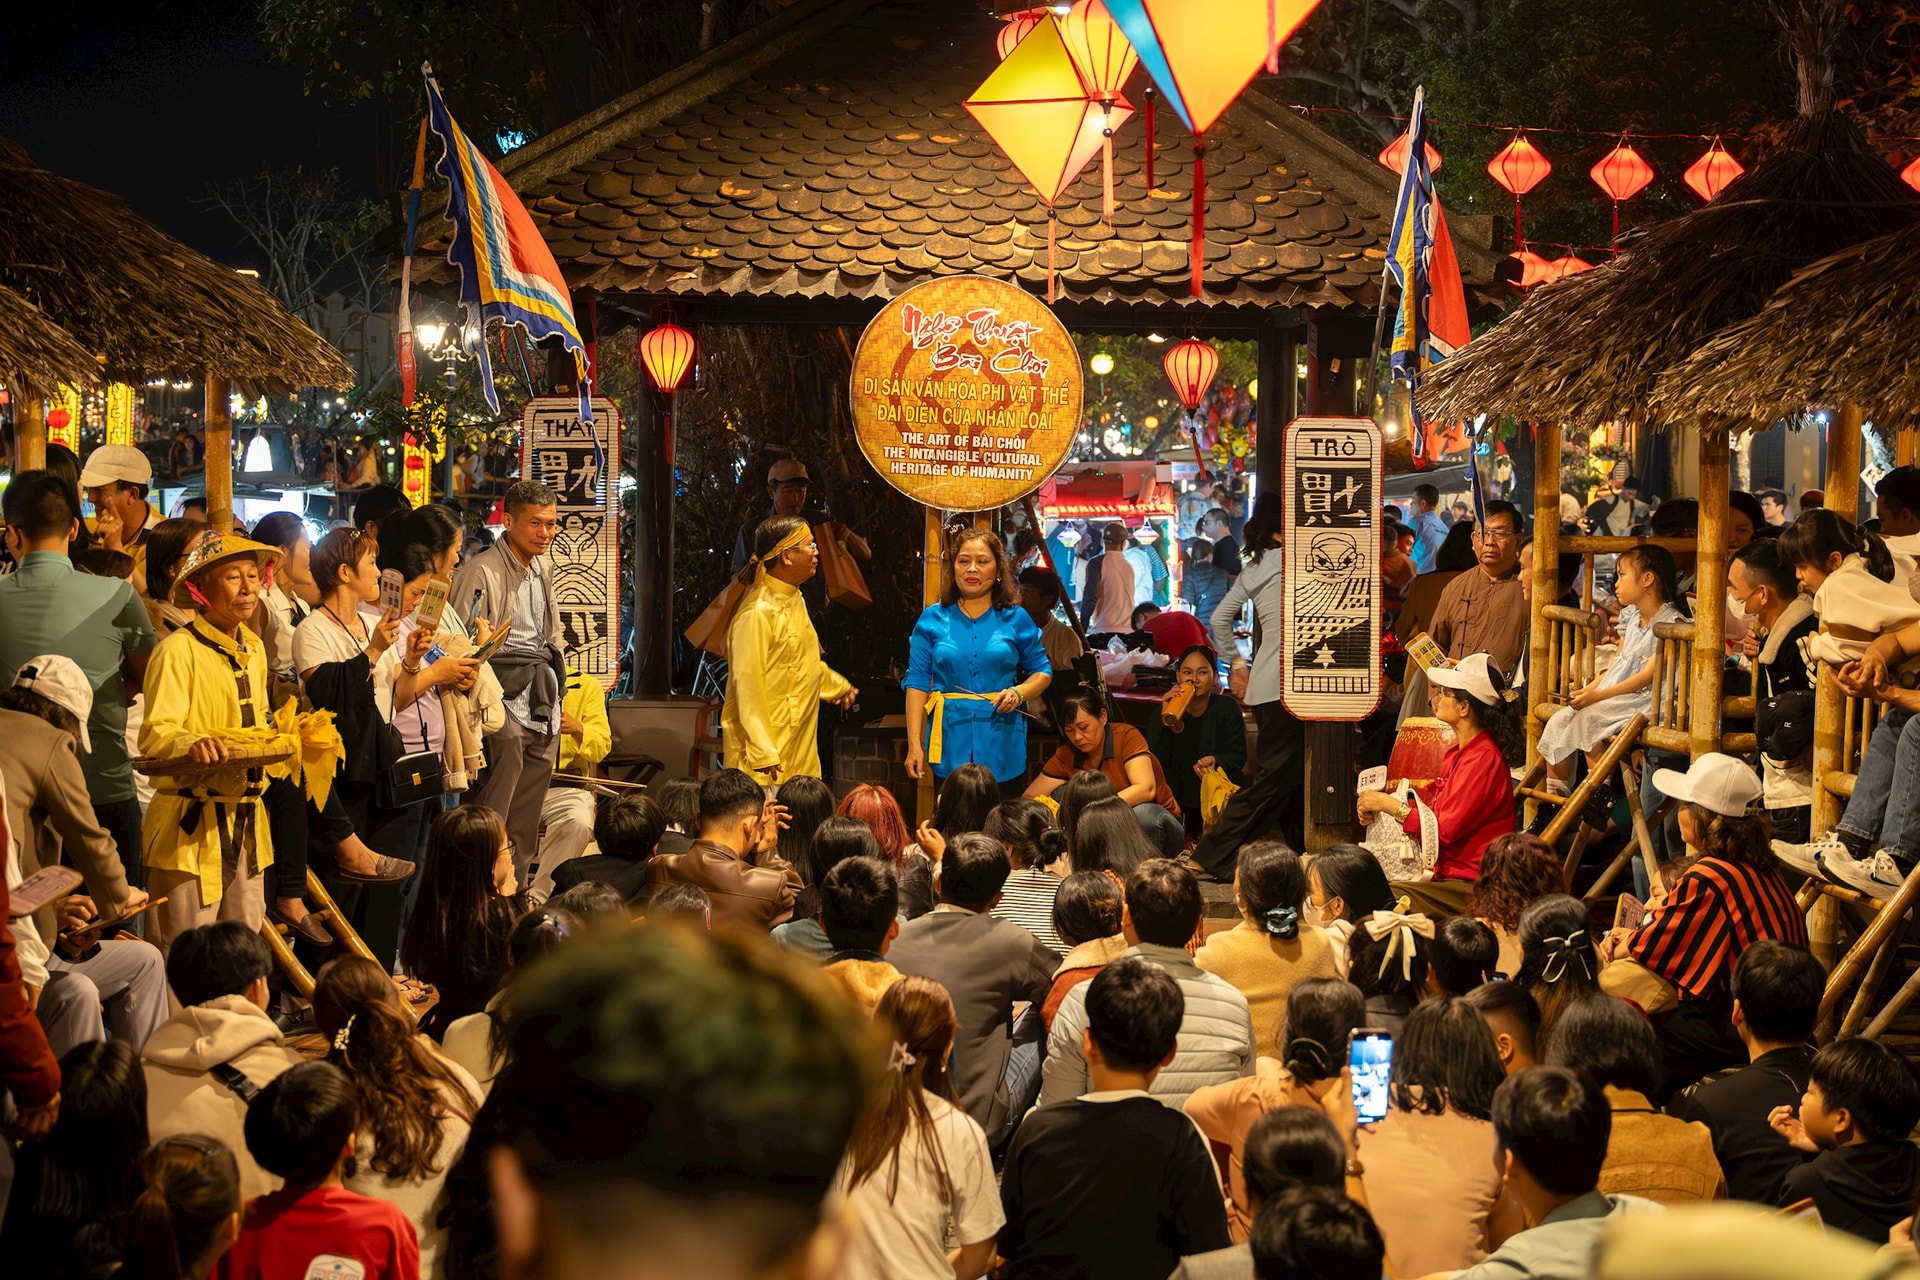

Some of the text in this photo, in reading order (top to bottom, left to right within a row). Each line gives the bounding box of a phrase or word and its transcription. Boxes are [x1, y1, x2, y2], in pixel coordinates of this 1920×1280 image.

[864, 372, 1069, 406] DI SẢN VĂN HÓA PHI VẬT THỂ
[877, 401, 1053, 433] ĐẠI DIỆN CỦA NHÂN LOẠI
[902, 432, 1026, 450] THE ART OF BÀI CHÒI
[1310, 435, 1357, 457] TRÒ
[883, 446, 1043, 467] THE INTANGIBLE CULTURAL
[891, 462, 1034, 481] HERITAGE OF HUMANITY
